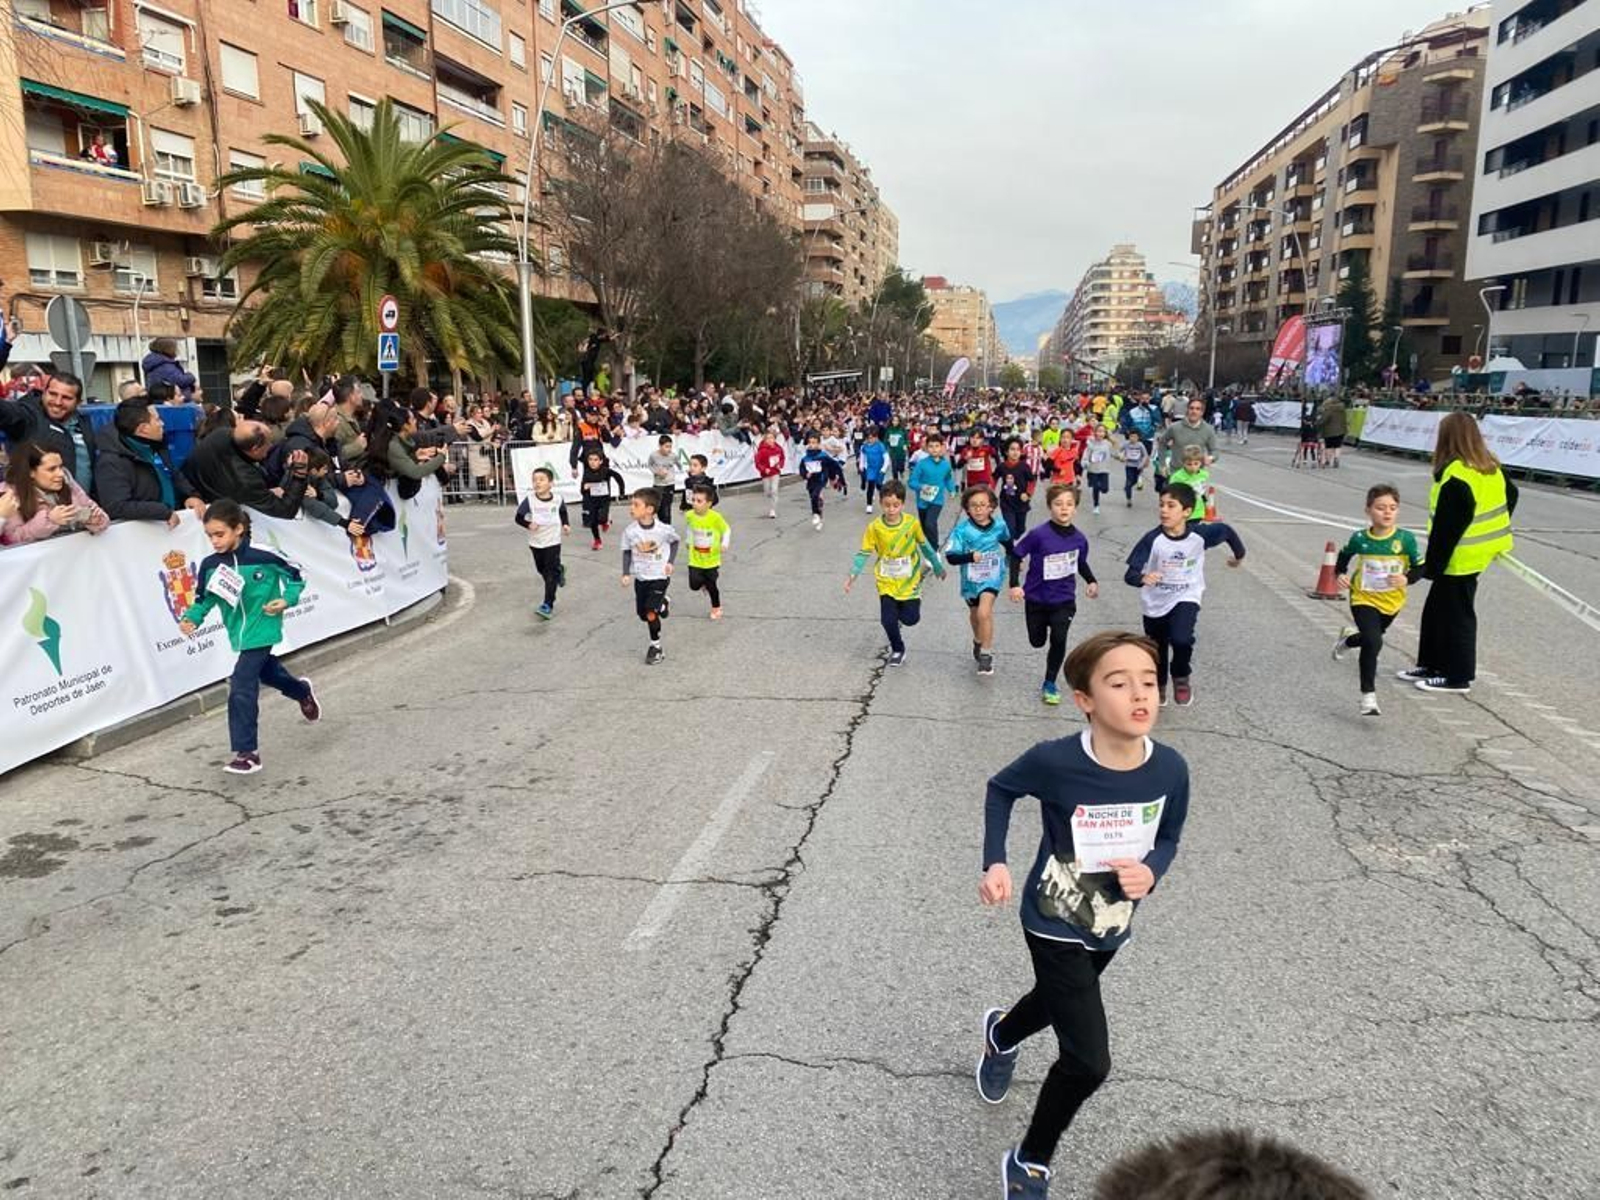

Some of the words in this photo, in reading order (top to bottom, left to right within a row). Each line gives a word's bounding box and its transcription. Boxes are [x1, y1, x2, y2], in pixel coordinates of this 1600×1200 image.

[156, 636, 186, 652] Excmo.
[186, 645, 197, 656] de
[13, 685, 58, 708] Patronato
[58, 670, 101, 691] Municipal
[101, 664, 113, 676] de
[29, 694, 71, 716] Deportes
[72, 687, 84, 700] de
[1089, 811, 1119, 819] NOCHE
[1121, 810, 1133, 818] DE
[1077, 821, 1097, 829] SAN
